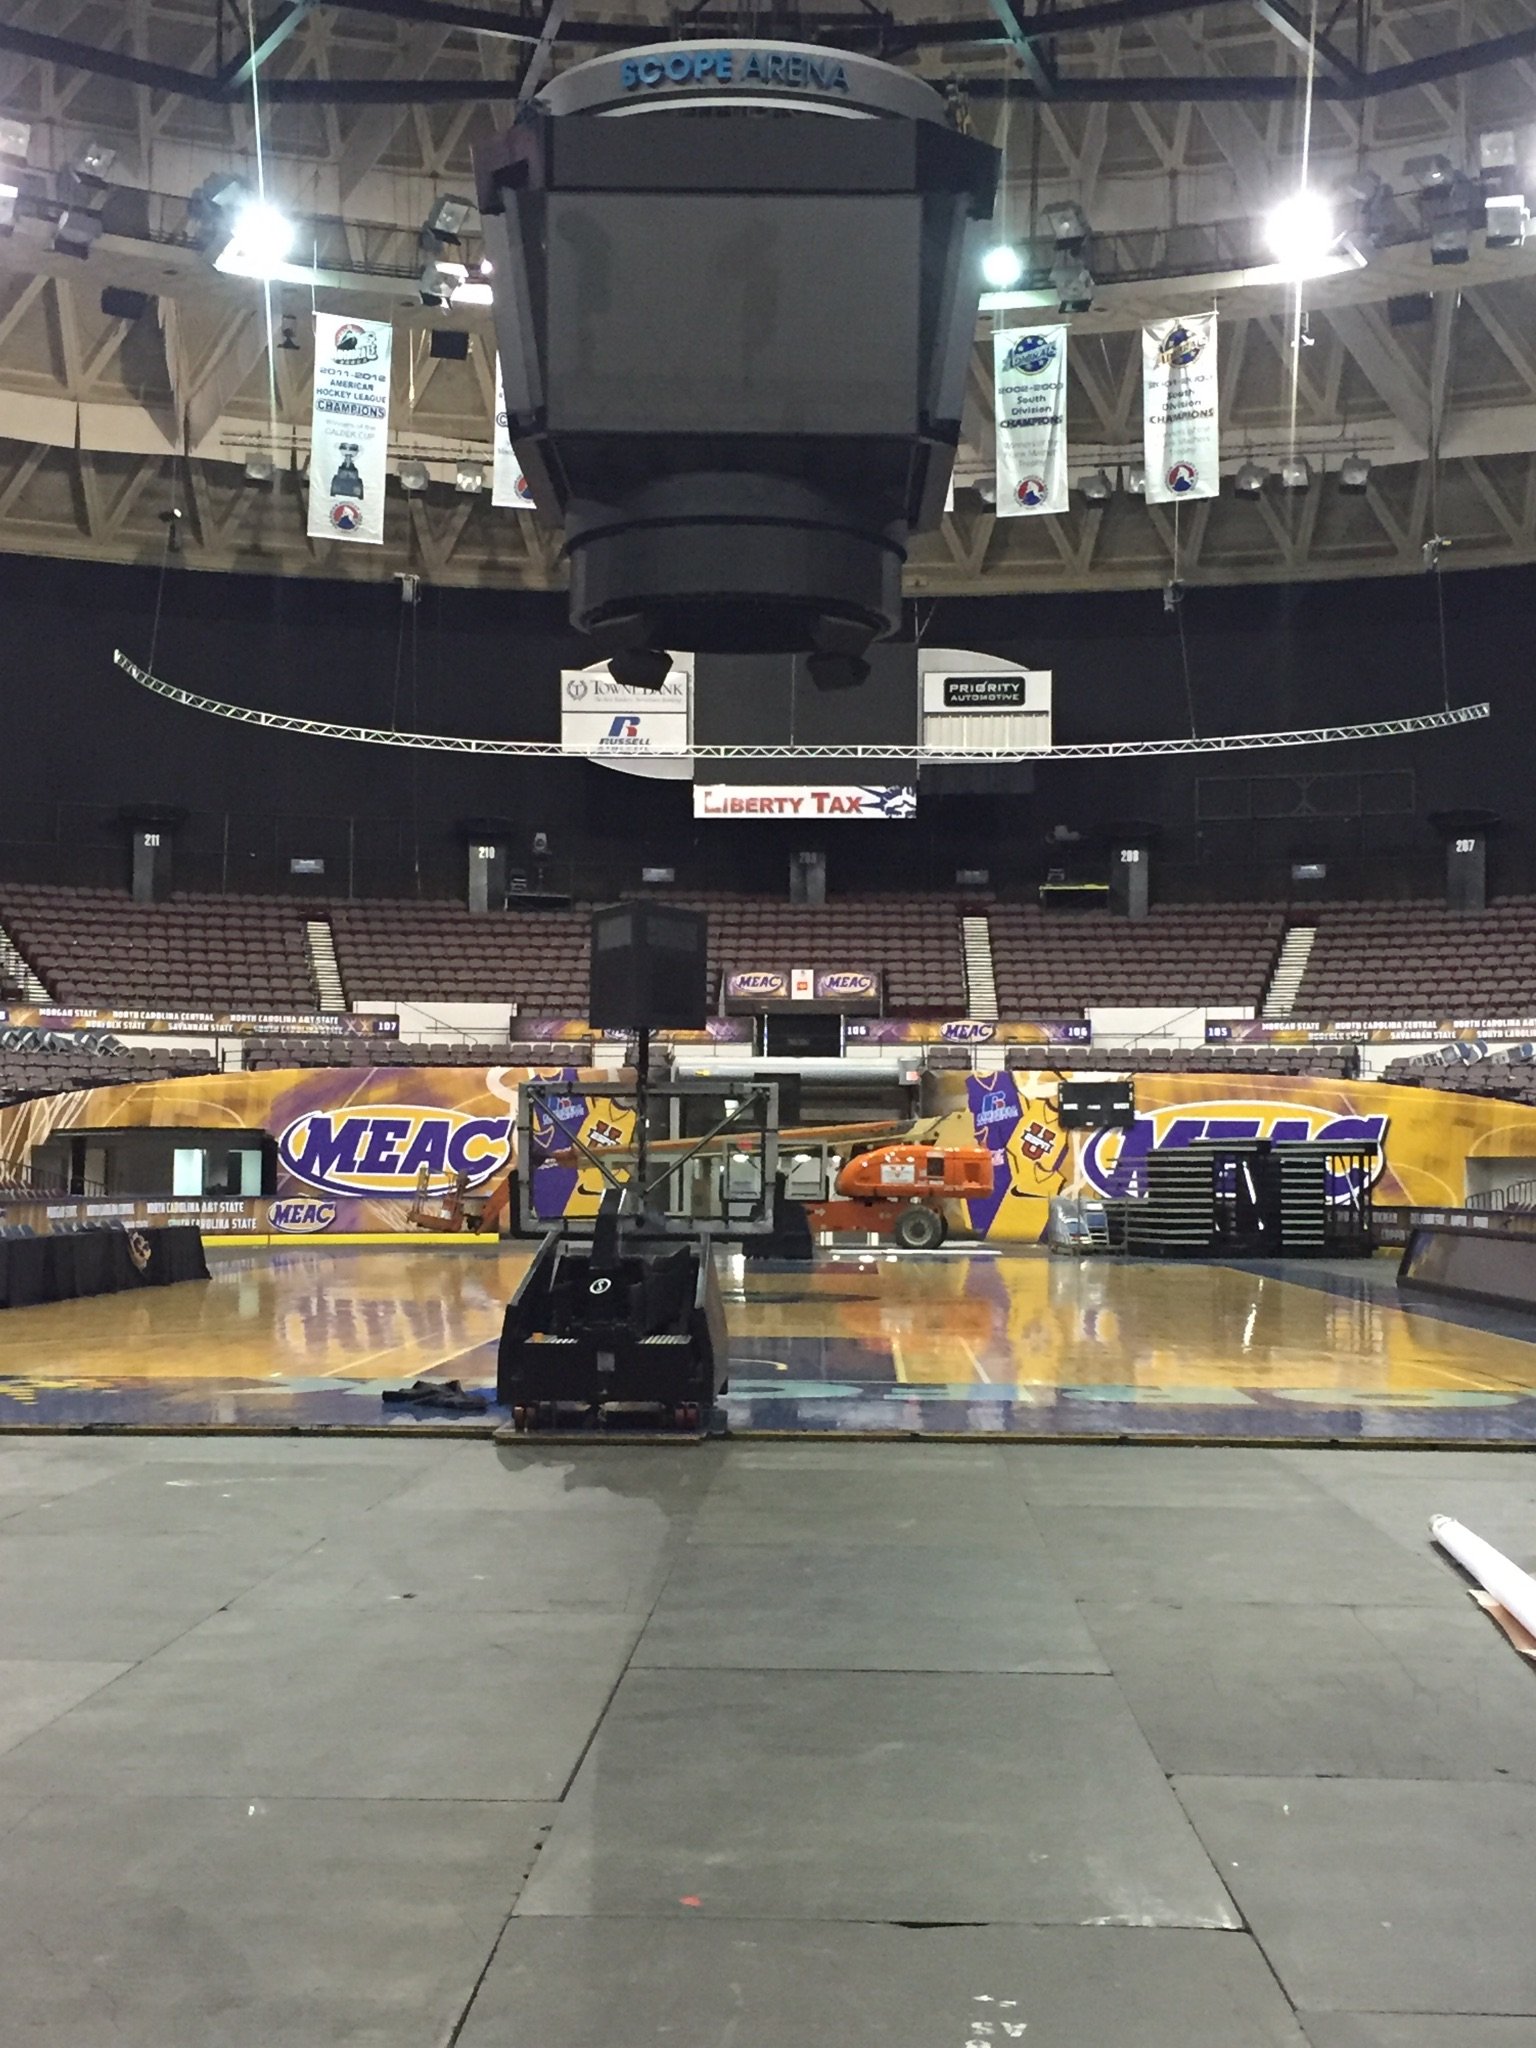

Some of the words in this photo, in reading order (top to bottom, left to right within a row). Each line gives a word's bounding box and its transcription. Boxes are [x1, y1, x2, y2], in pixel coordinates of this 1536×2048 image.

[620, 50, 732, 91] SCOPE
[741, 52, 850, 93] ARENA
[330, 378, 374, 391] AMERICAN
[316, 387, 352, 399] HOCKEY
[353, 392, 387, 404] LEAGUE
[1017, 394, 1046, 404] South
[317, 399, 386, 418] CHAMPIONS
[1011, 405, 1052, 416] Division
[1162, 399, 1201, 411] Division
[1000, 415, 1063, 429] CHAMPIONS
[1149, 408, 1214, 424] CHAMPIONS
[949, 681, 1020, 693] PRIORITY
[704, 791, 804, 814] LIBERTY
[811, 792, 863, 815] TAX
[144, 834, 160, 846] 211
[1456, 839, 1475, 853] 207
[478, 847, 496, 859] 210
[738, 976, 781, 988] MEAC
[827, 976, 872, 988] MEAC
[74, 1009, 97, 1017] STATE
[112, 1011, 139, 1019] NORTH
[140, 1011, 179, 1020] CAROLINA
[180, 1012, 215, 1021] CENTRAL
[122, 1021, 146, 1030] STATE
[230, 1014, 257, 1022] NORTH
[258, 1014, 297, 1023] CAROLINA
[316, 1016, 339, 1025] STATE
[1363, 1021, 1401, 1030] CAROLINA
[1453, 1020, 1481, 1028] NORTH
[1482, 1019, 1521, 1028] CAROLINA
[210, 1023, 233, 1032] STATE
[378, 1021, 397, 1031] 107
[847, 1026, 866, 1035] 106
[945, 1024, 992, 1039] MEAC
[1068, 1027, 1088, 1037] 106
[1208, 1027, 1228, 1037] 105
[1297, 1022, 1320, 1031] STATE
[1433, 1030, 1456, 1039] STATE
[1477, 1030, 1503, 1038] SOUTH
[296, 1117, 510, 1178] MEAC
[220, 1202, 244, 1212] STATE
[273, 1204, 334, 1225] MEAC
[232, 1218, 257, 1230] STATE
